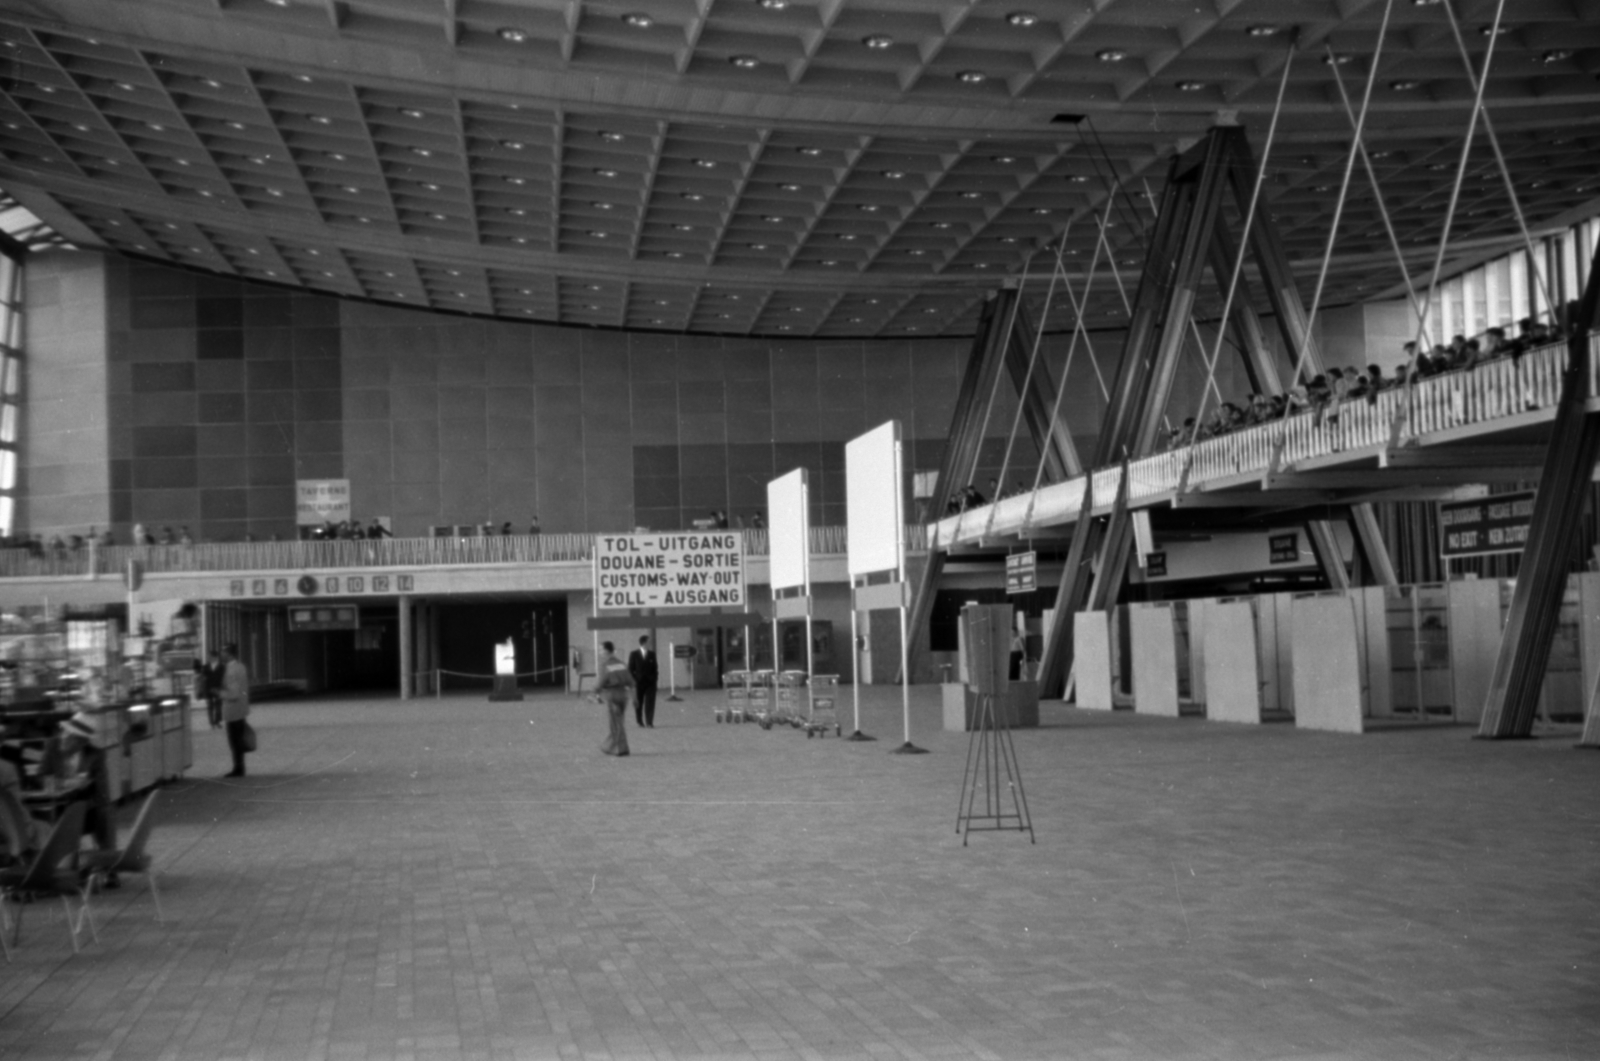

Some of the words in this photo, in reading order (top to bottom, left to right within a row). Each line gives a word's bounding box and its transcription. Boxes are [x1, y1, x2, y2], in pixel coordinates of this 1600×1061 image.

[604, 538, 640, 551] TOL
[659, 535, 735, 551] UITGANG
[1449, 533, 1459, 549] NO
[1461, 530, 1478, 548] EXIT
[601, 555, 665, 570] DOUANE
[683, 552, 739, 568] SORTIE
[349, 577, 362, 592] 10
[374, 576, 387, 592] 12
[399, 576, 412, 591] 14
[603, 591, 645, 606] ZOLL
[664, 589, 739, 604] AUSGANG
